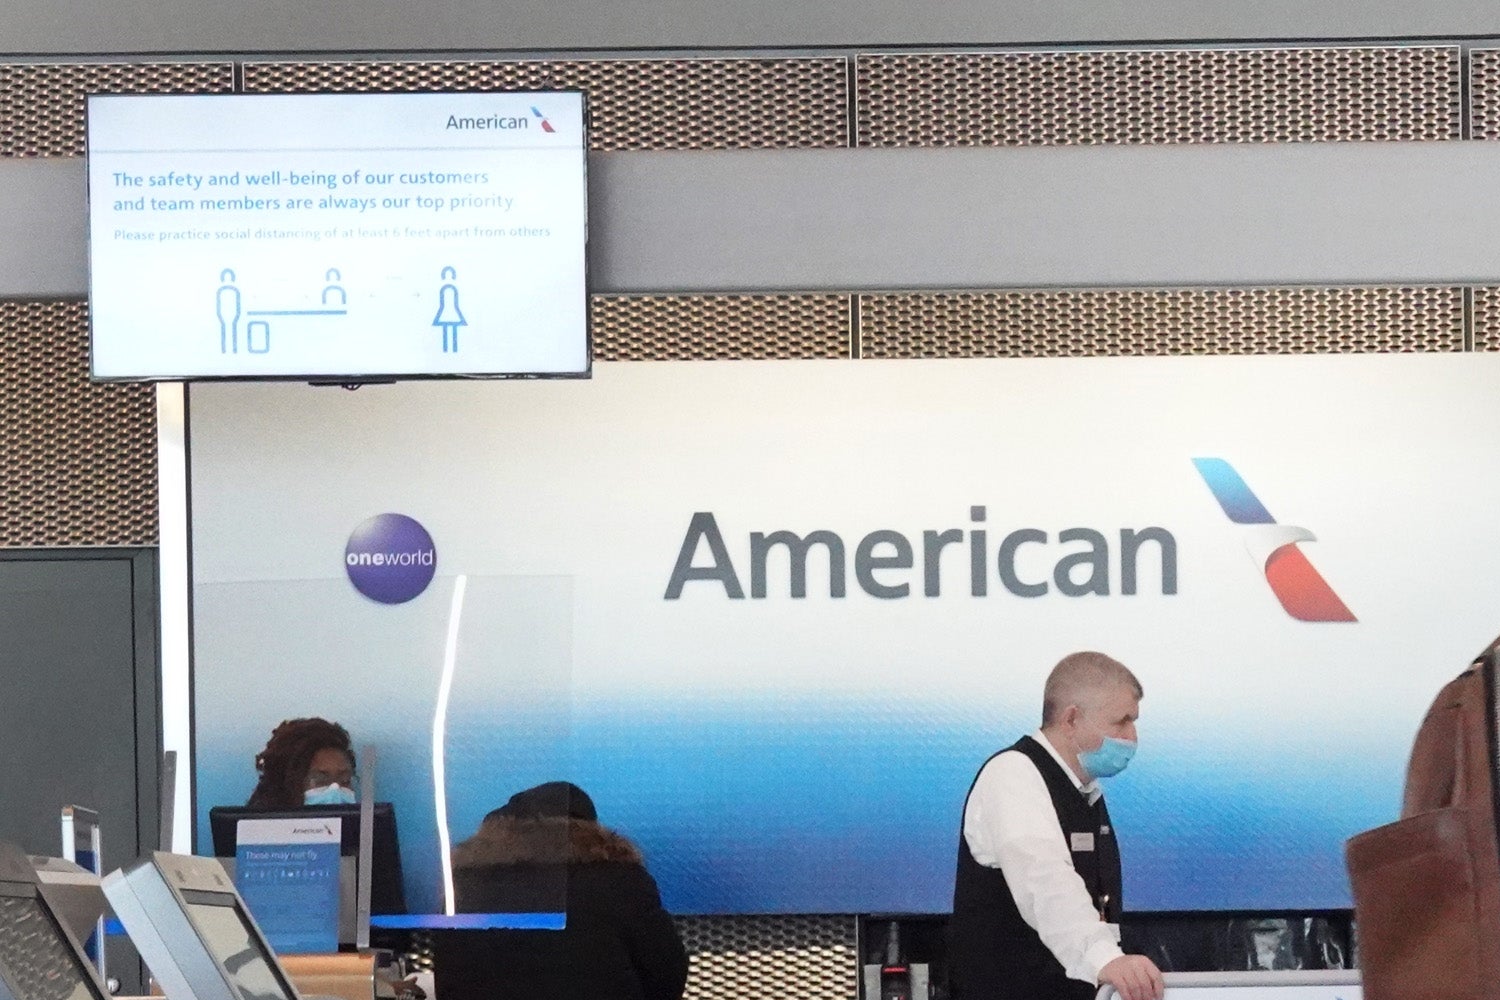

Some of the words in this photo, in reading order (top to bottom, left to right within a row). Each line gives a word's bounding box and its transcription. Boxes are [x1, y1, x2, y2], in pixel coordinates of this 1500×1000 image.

[445, 114, 528, 131] American
[113, 173, 143, 187] The
[149, 171, 203, 190] safety
[208, 171, 239, 186] and
[246, 171, 336, 189] well-being
[342, 170, 360, 185] of
[365, 173, 394, 185] our
[400, 171, 489, 184] customers
[113, 196, 145, 211] and
[151, 197, 194, 210] team
[200, 196, 280, 210] members
[286, 198, 313, 210] are
[319, 195, 377, 212] always
[382, 197, 410, 208] our
[416, 196, 444, 212] top
[450, 193, 514, 211] priority
[114, 229, 155, 241] Please
[159, 228, 210, 243] practice
[215, 228, 250, 240] social
[254, 227, 321, 241] distancing
[324, 227, 338, 239] of
[342, 228, 354, 239] at
[358, 228, 388, 238] least
[404, 227, 431, 238] feet
[435, 228, 469, 241] apart
[474, 226, 506, 238] from
[510, 226, 551, 238] others
[346, 549, 433, 566] oneworld
[662, 505, 1178, 600] American
